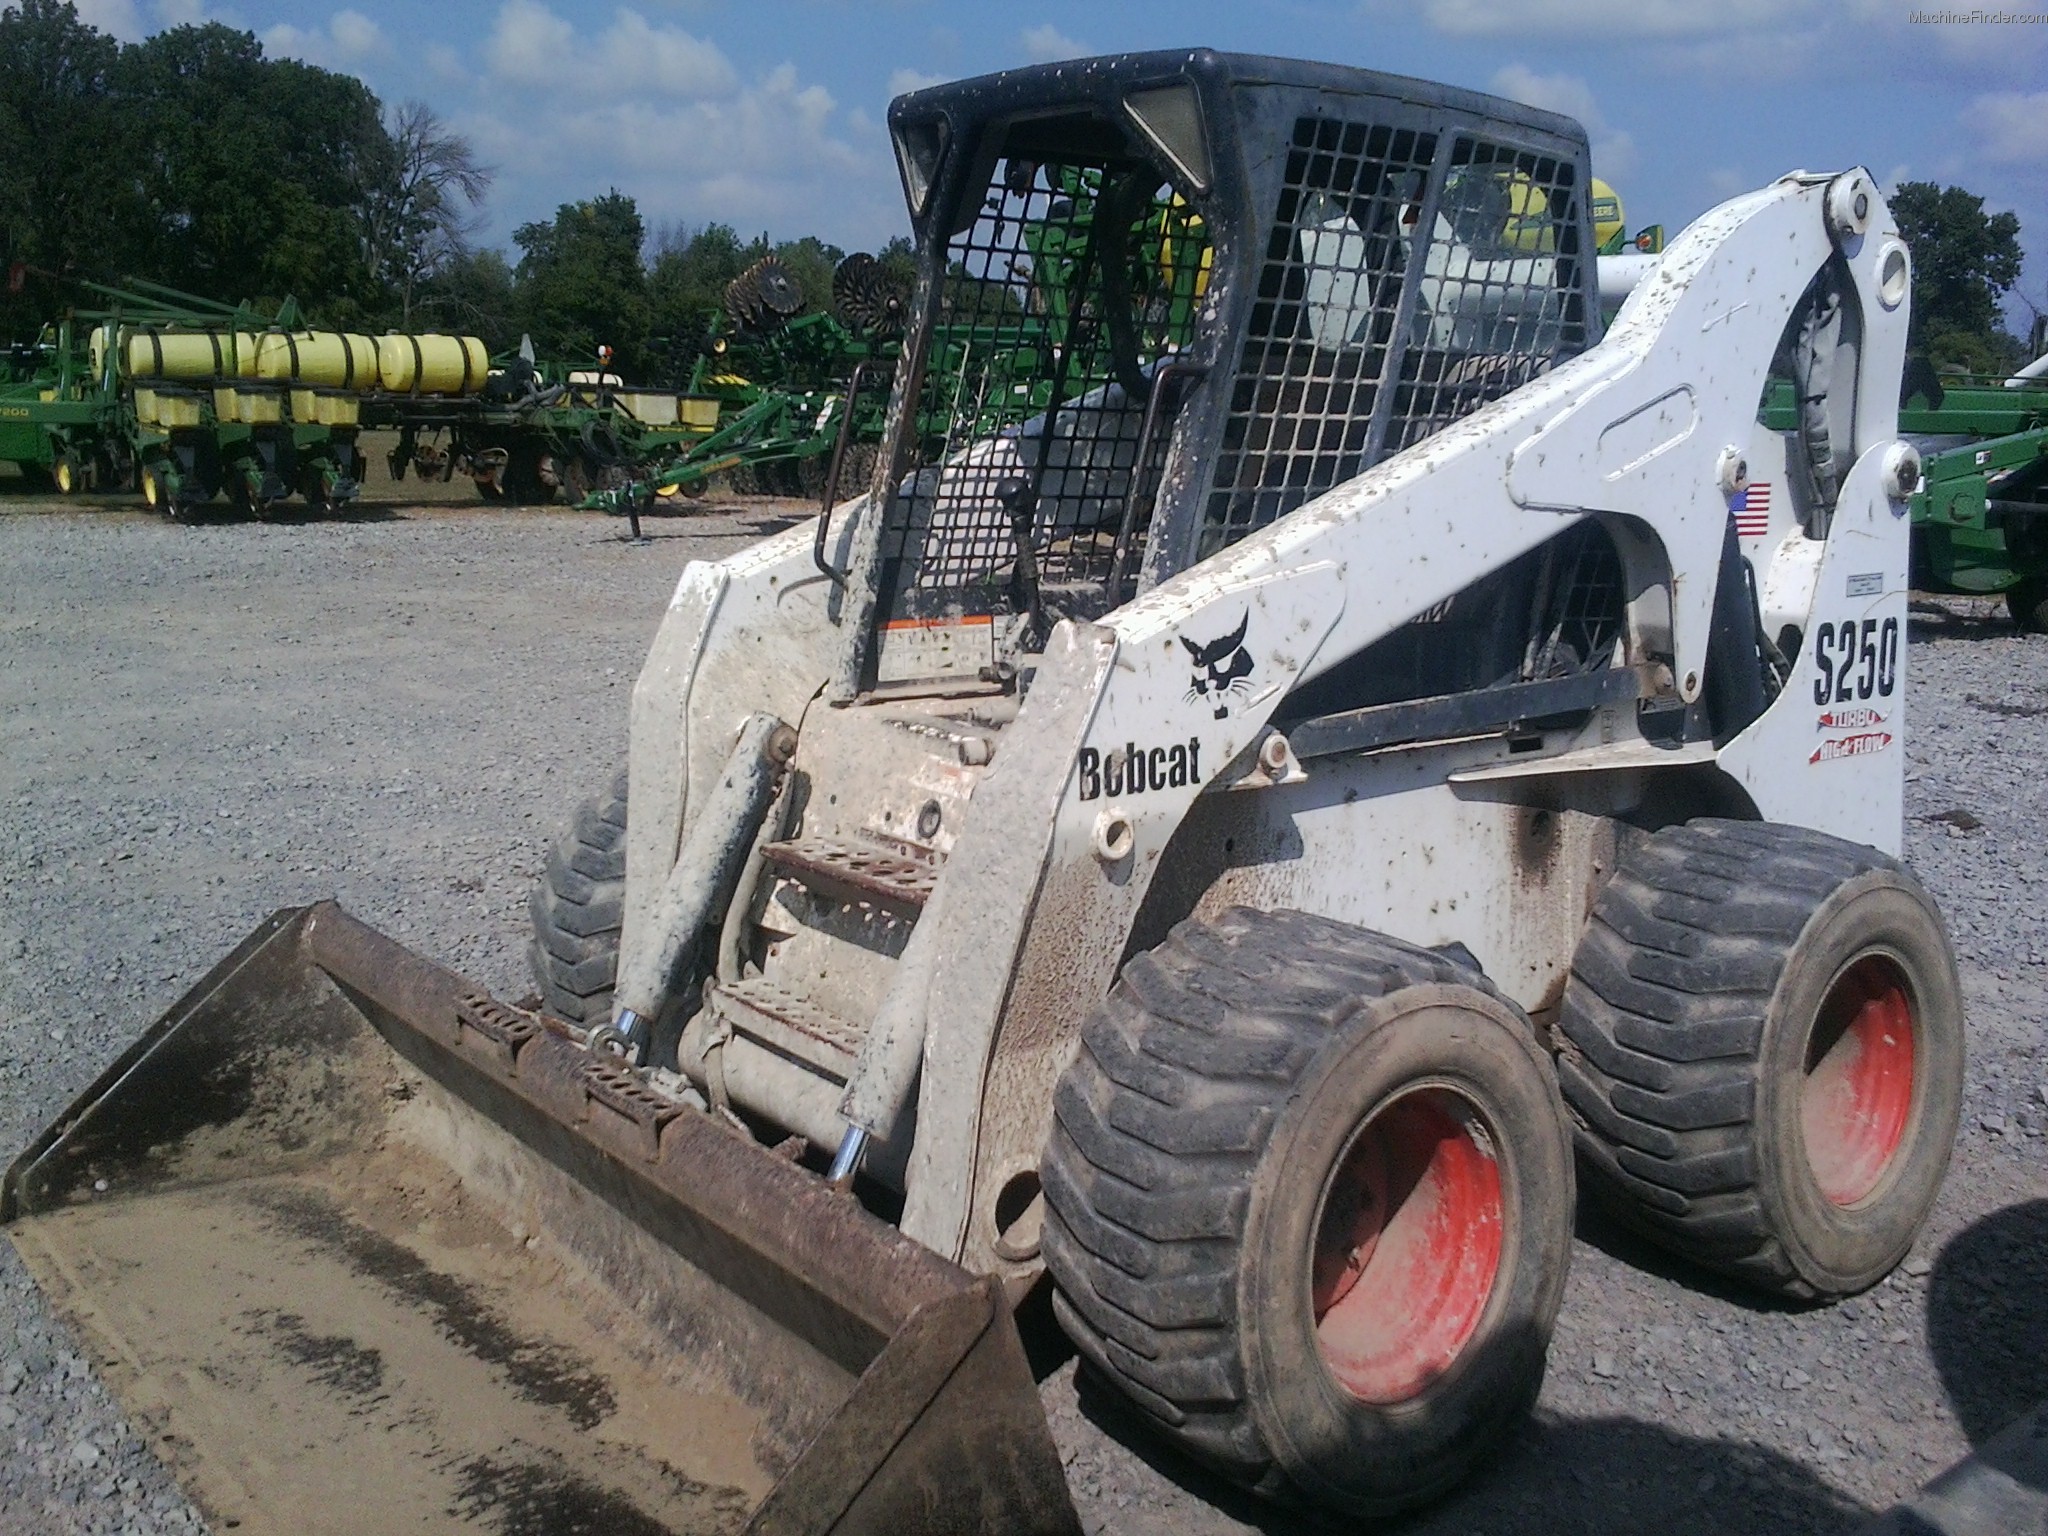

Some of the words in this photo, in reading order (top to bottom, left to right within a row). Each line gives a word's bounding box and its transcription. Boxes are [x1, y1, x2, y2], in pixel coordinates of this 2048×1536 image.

[1592, 205, 1615, 217] EERE
[0, 407, 29, 417] 200
[1814, 616, 1898, 705] S250
[1829, 709, 1876, 727] TURBO
[1080, 737, 1201, 801] Bobcat
